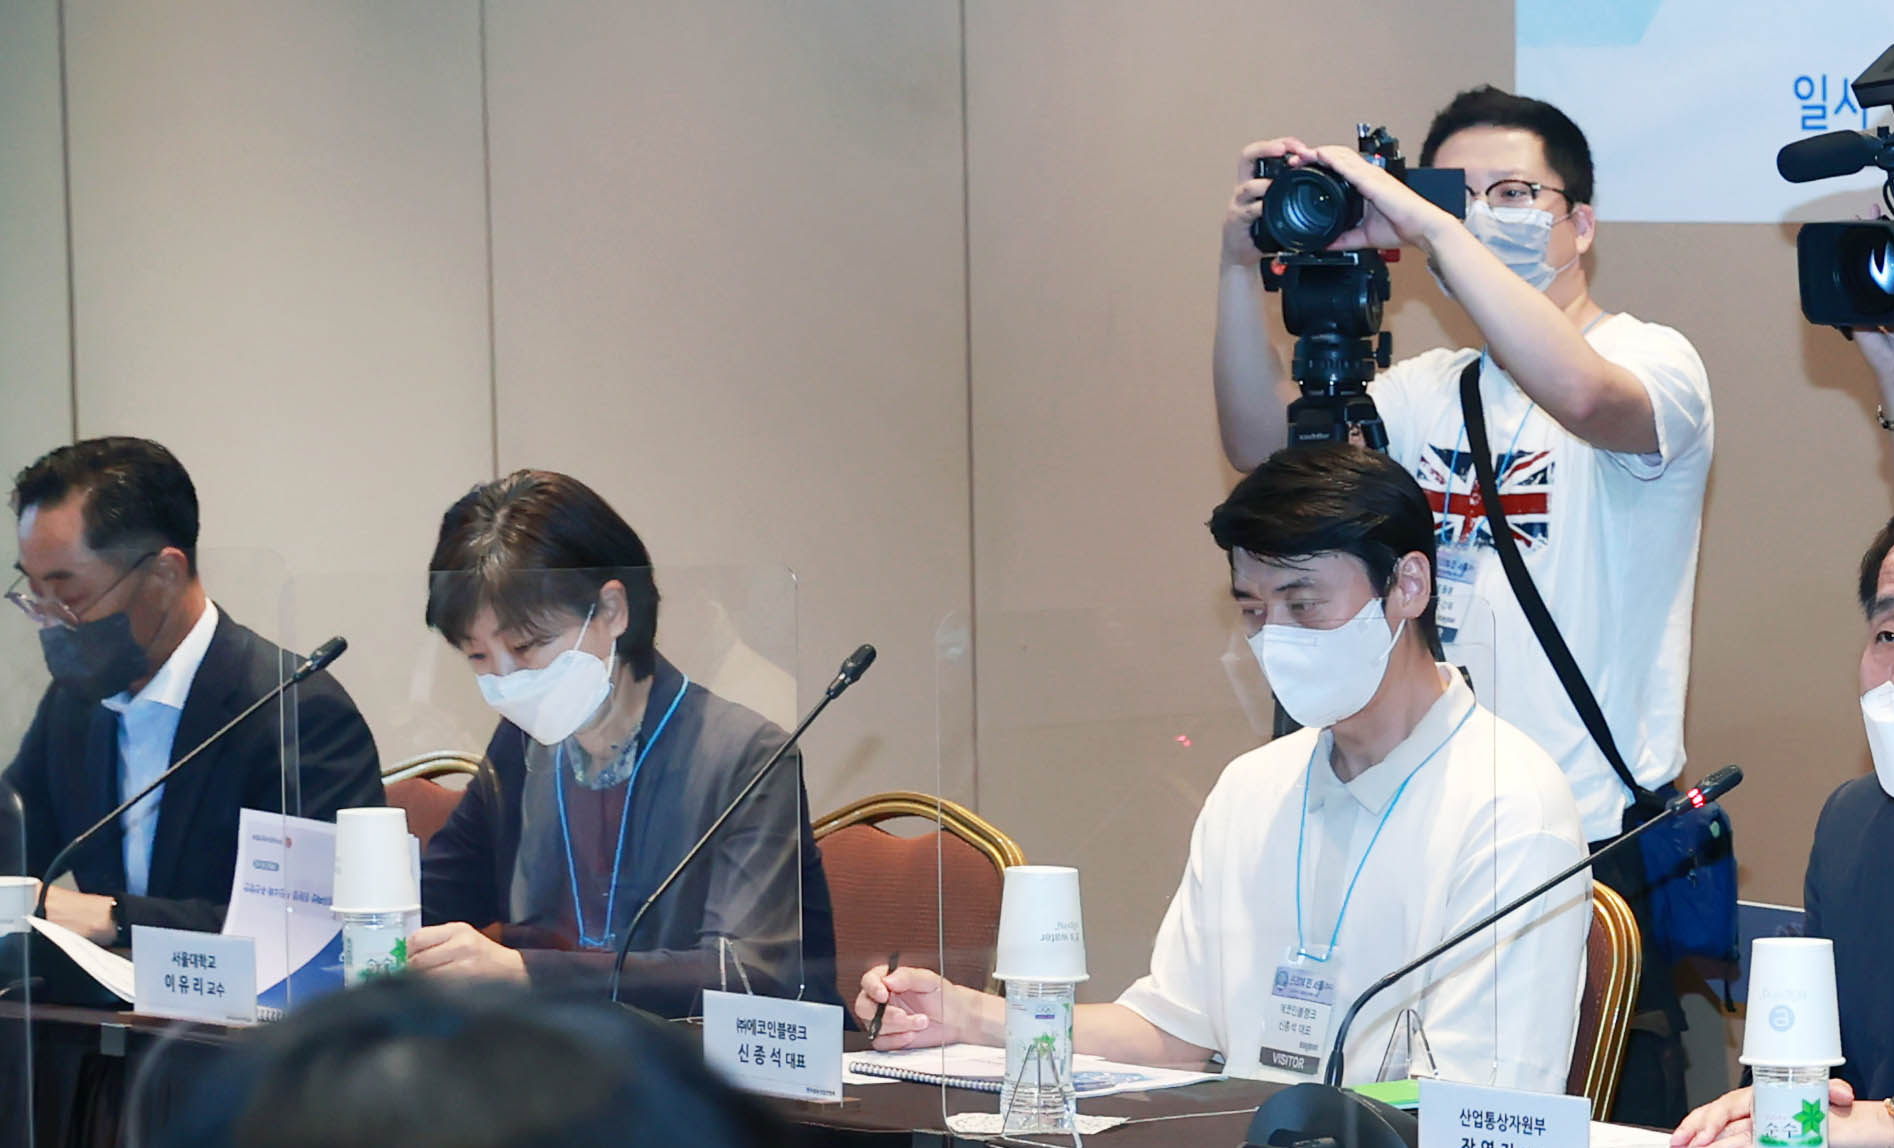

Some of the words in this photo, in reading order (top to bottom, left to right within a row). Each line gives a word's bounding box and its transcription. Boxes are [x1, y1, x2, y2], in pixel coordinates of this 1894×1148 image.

[172, 951, 217, 970] 서울대학교
[206, 981, 226, 998] 교수
[785, 1052, 807, 1070] 대표
[1272, 1051, 1305, 1070] VISITOR
[1459, 1107, 1547, 1137] 산업통상자원부
